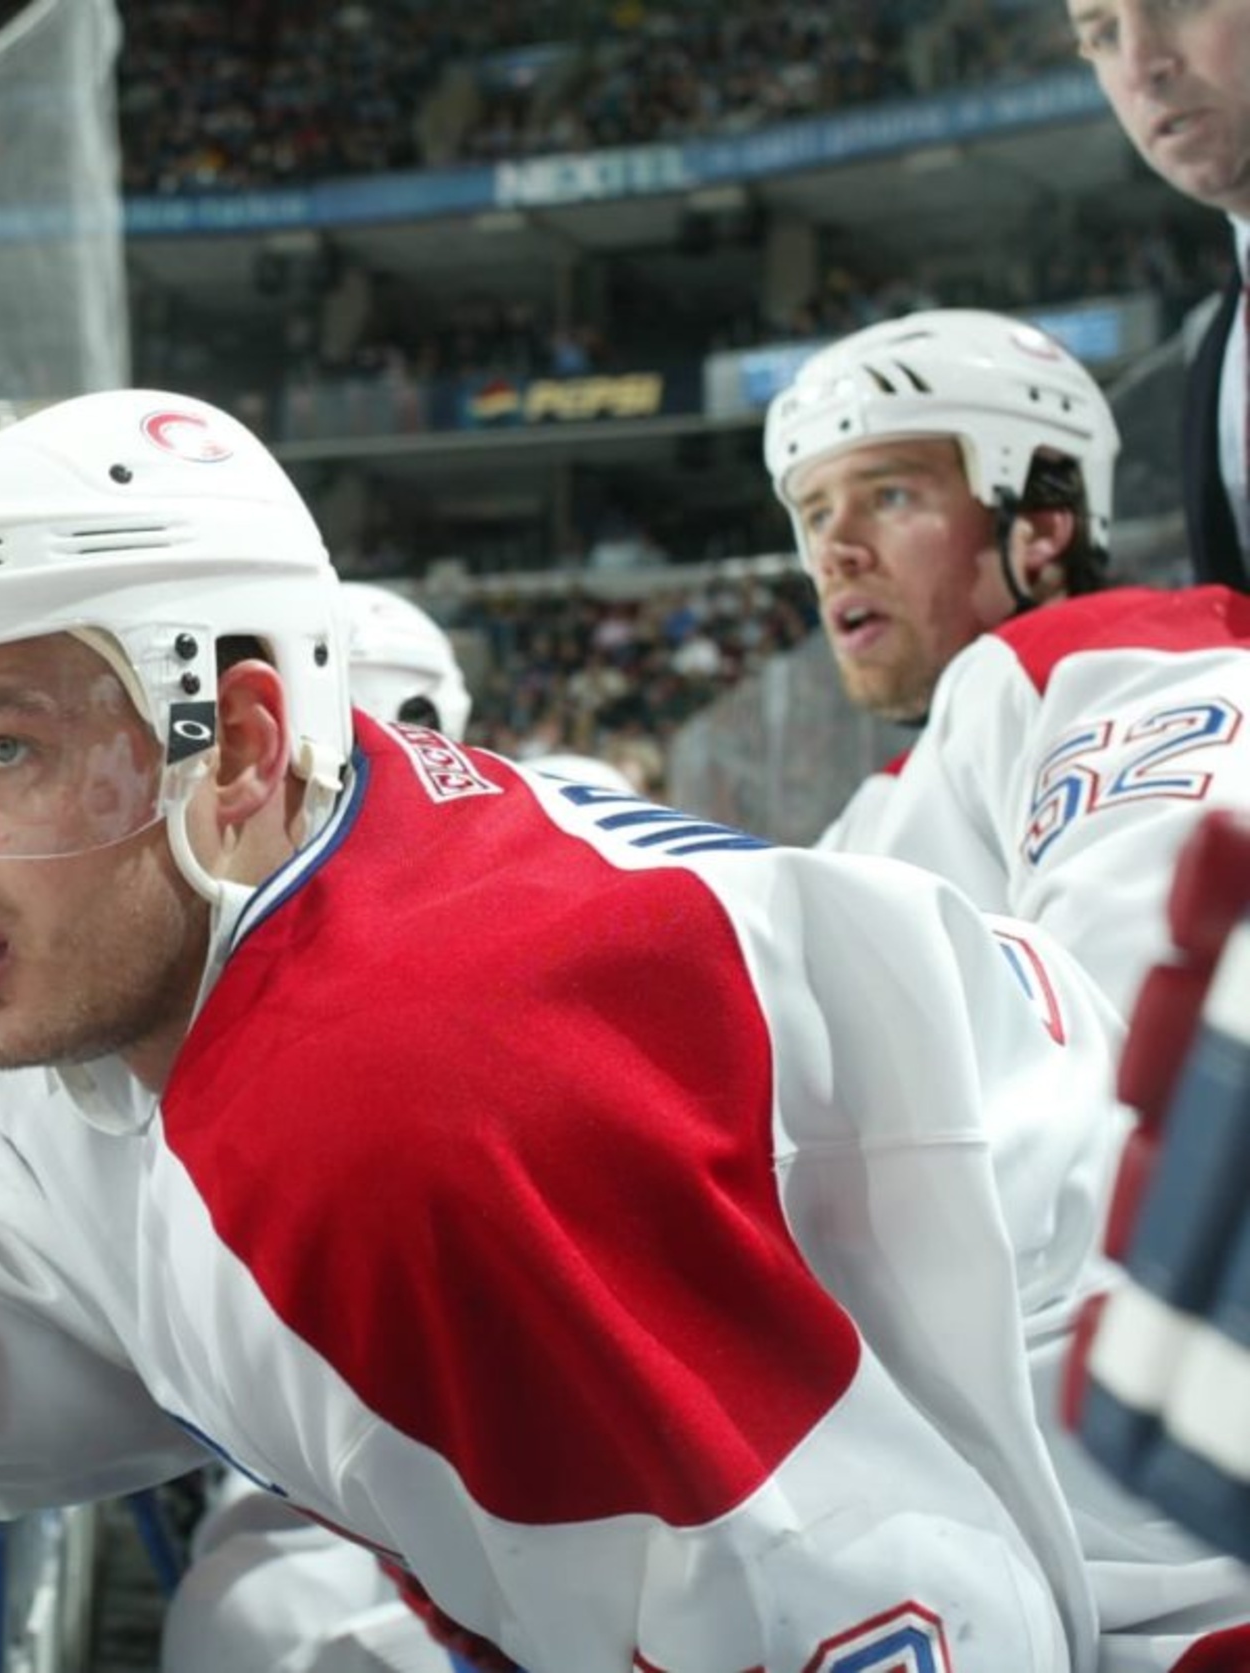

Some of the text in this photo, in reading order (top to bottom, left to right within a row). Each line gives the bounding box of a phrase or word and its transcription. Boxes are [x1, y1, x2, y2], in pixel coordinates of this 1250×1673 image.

[494, 143, 686, 208] NEXTEL
[523, 373, 664, 422] PEPSI
[1021, 697, 1244, 867] 52
